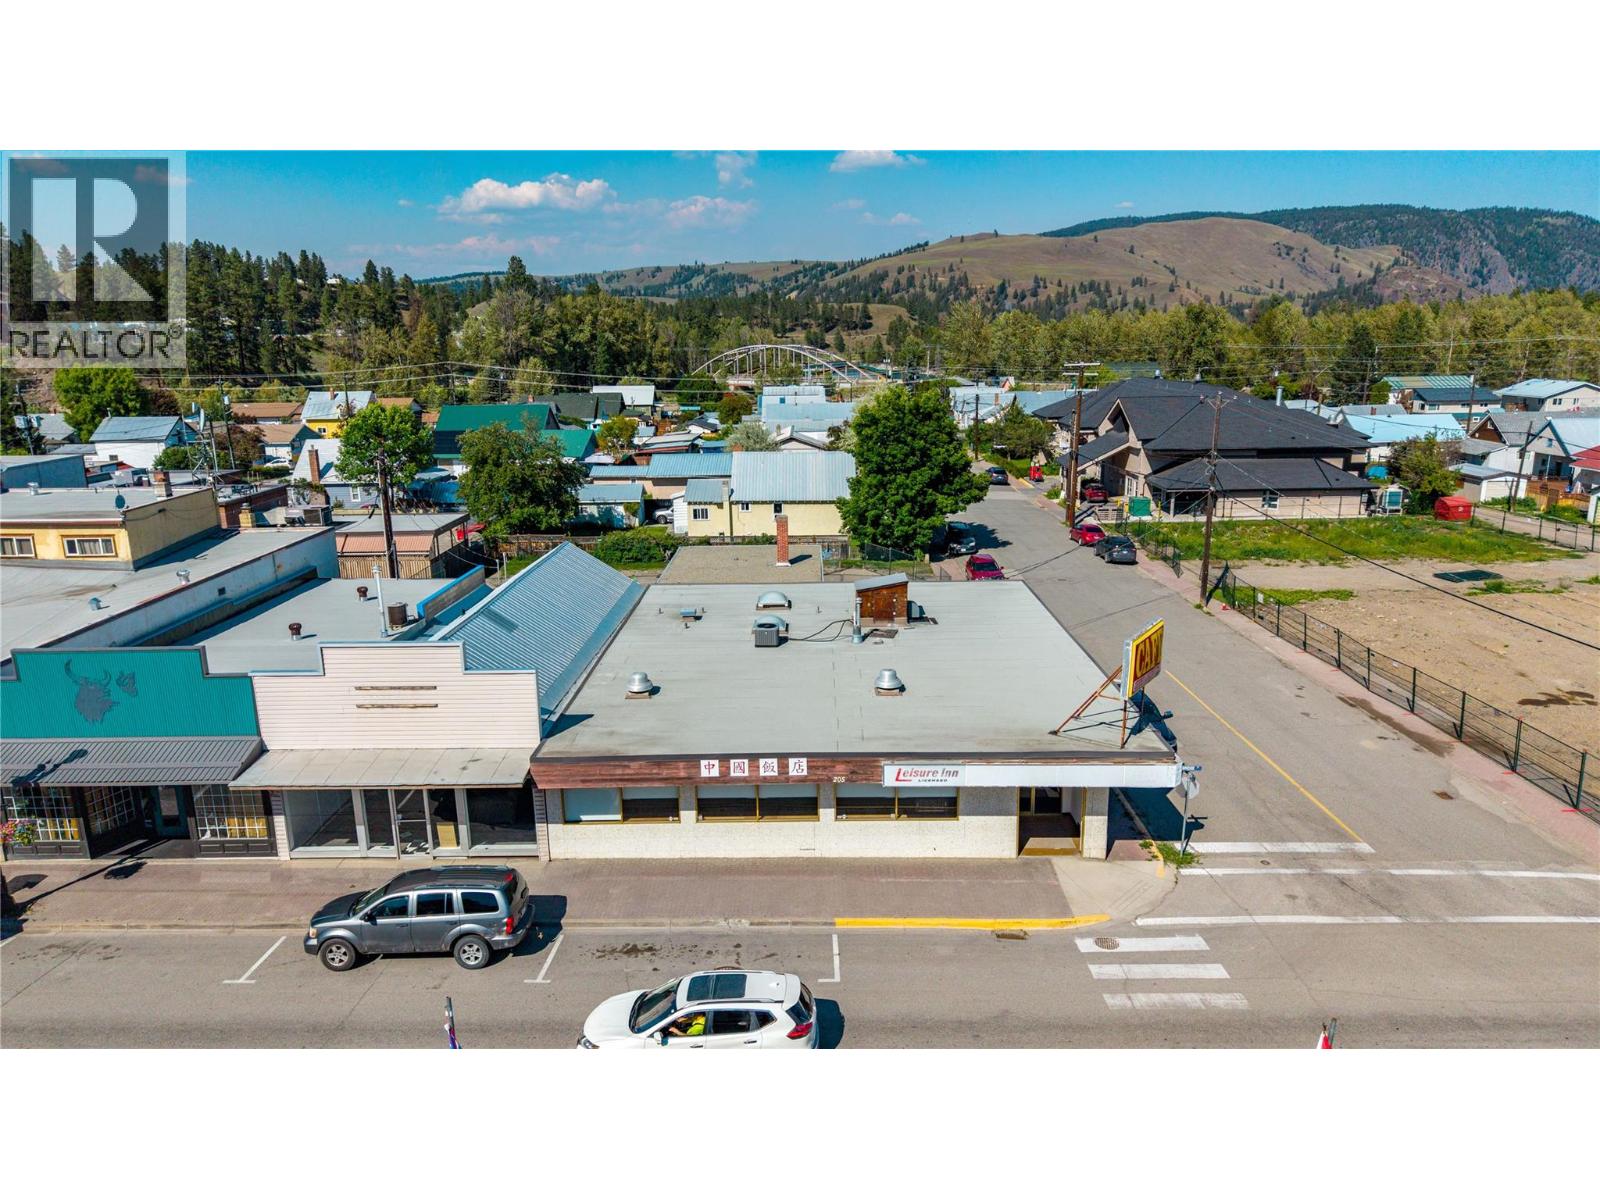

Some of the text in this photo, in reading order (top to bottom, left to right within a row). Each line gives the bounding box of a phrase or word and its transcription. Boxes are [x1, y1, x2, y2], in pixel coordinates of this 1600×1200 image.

[704, 759, 804, 775] 中國飯店
[895, 767, 959, 782] Leisure Inn
